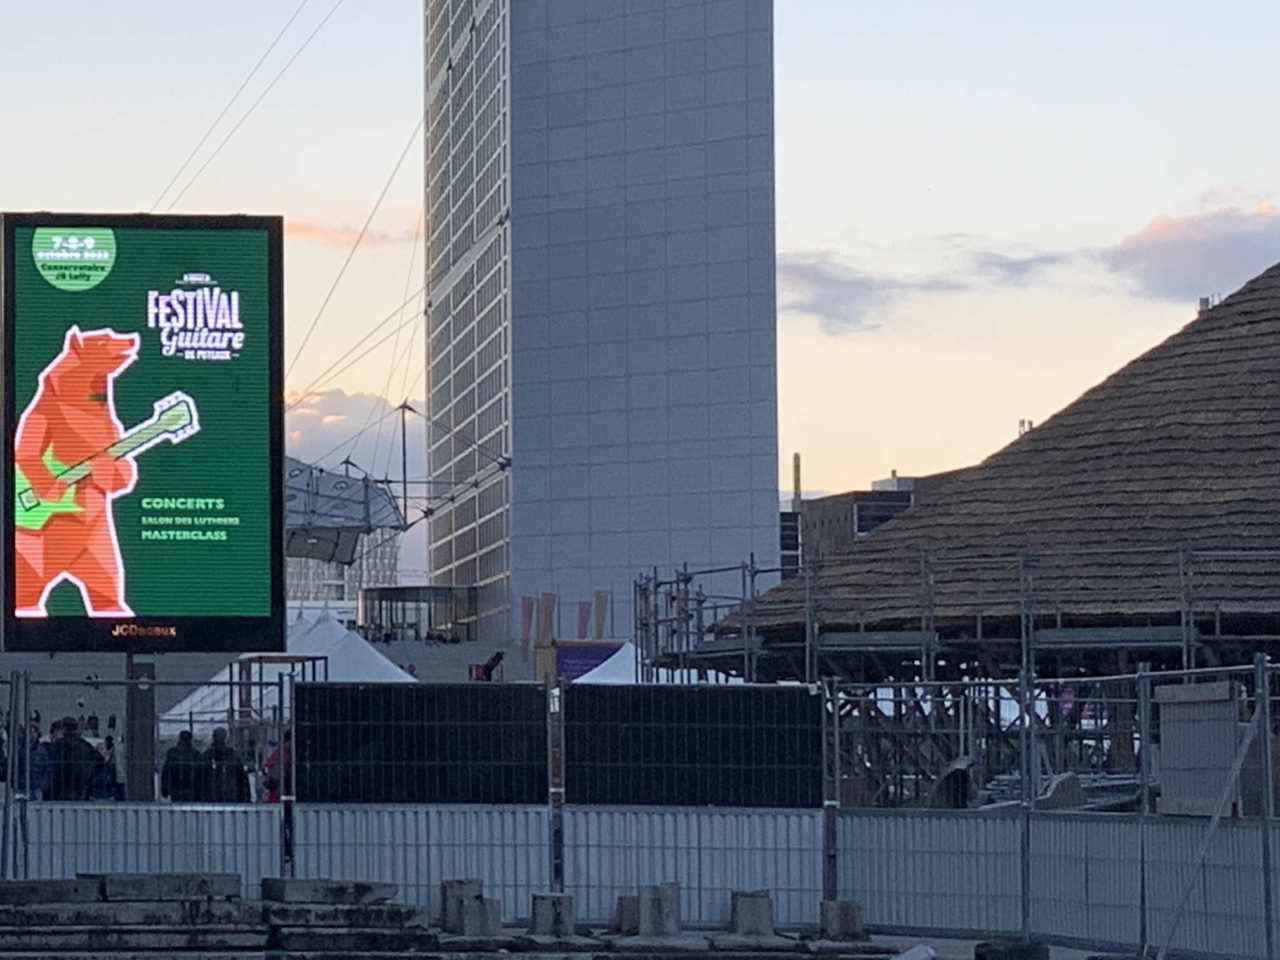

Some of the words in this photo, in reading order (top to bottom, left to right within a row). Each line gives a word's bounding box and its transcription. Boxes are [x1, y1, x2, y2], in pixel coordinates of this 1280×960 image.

[41, 263, 106, 272] Conservatoire
[147, 287, 243, 330] FESTIVAL
[160, 326, 245, 356] Guitare
[141, 497, 225, 510] CONCERTS
[141, 516, 173, 525] SALON
[174, 516, 192, 525] DES
[193, 516, 240, 526] LUTHIERS
[141, 530, 228, 541] MASTERCLASS
[111, 623, 177, 637] JCDecaux
